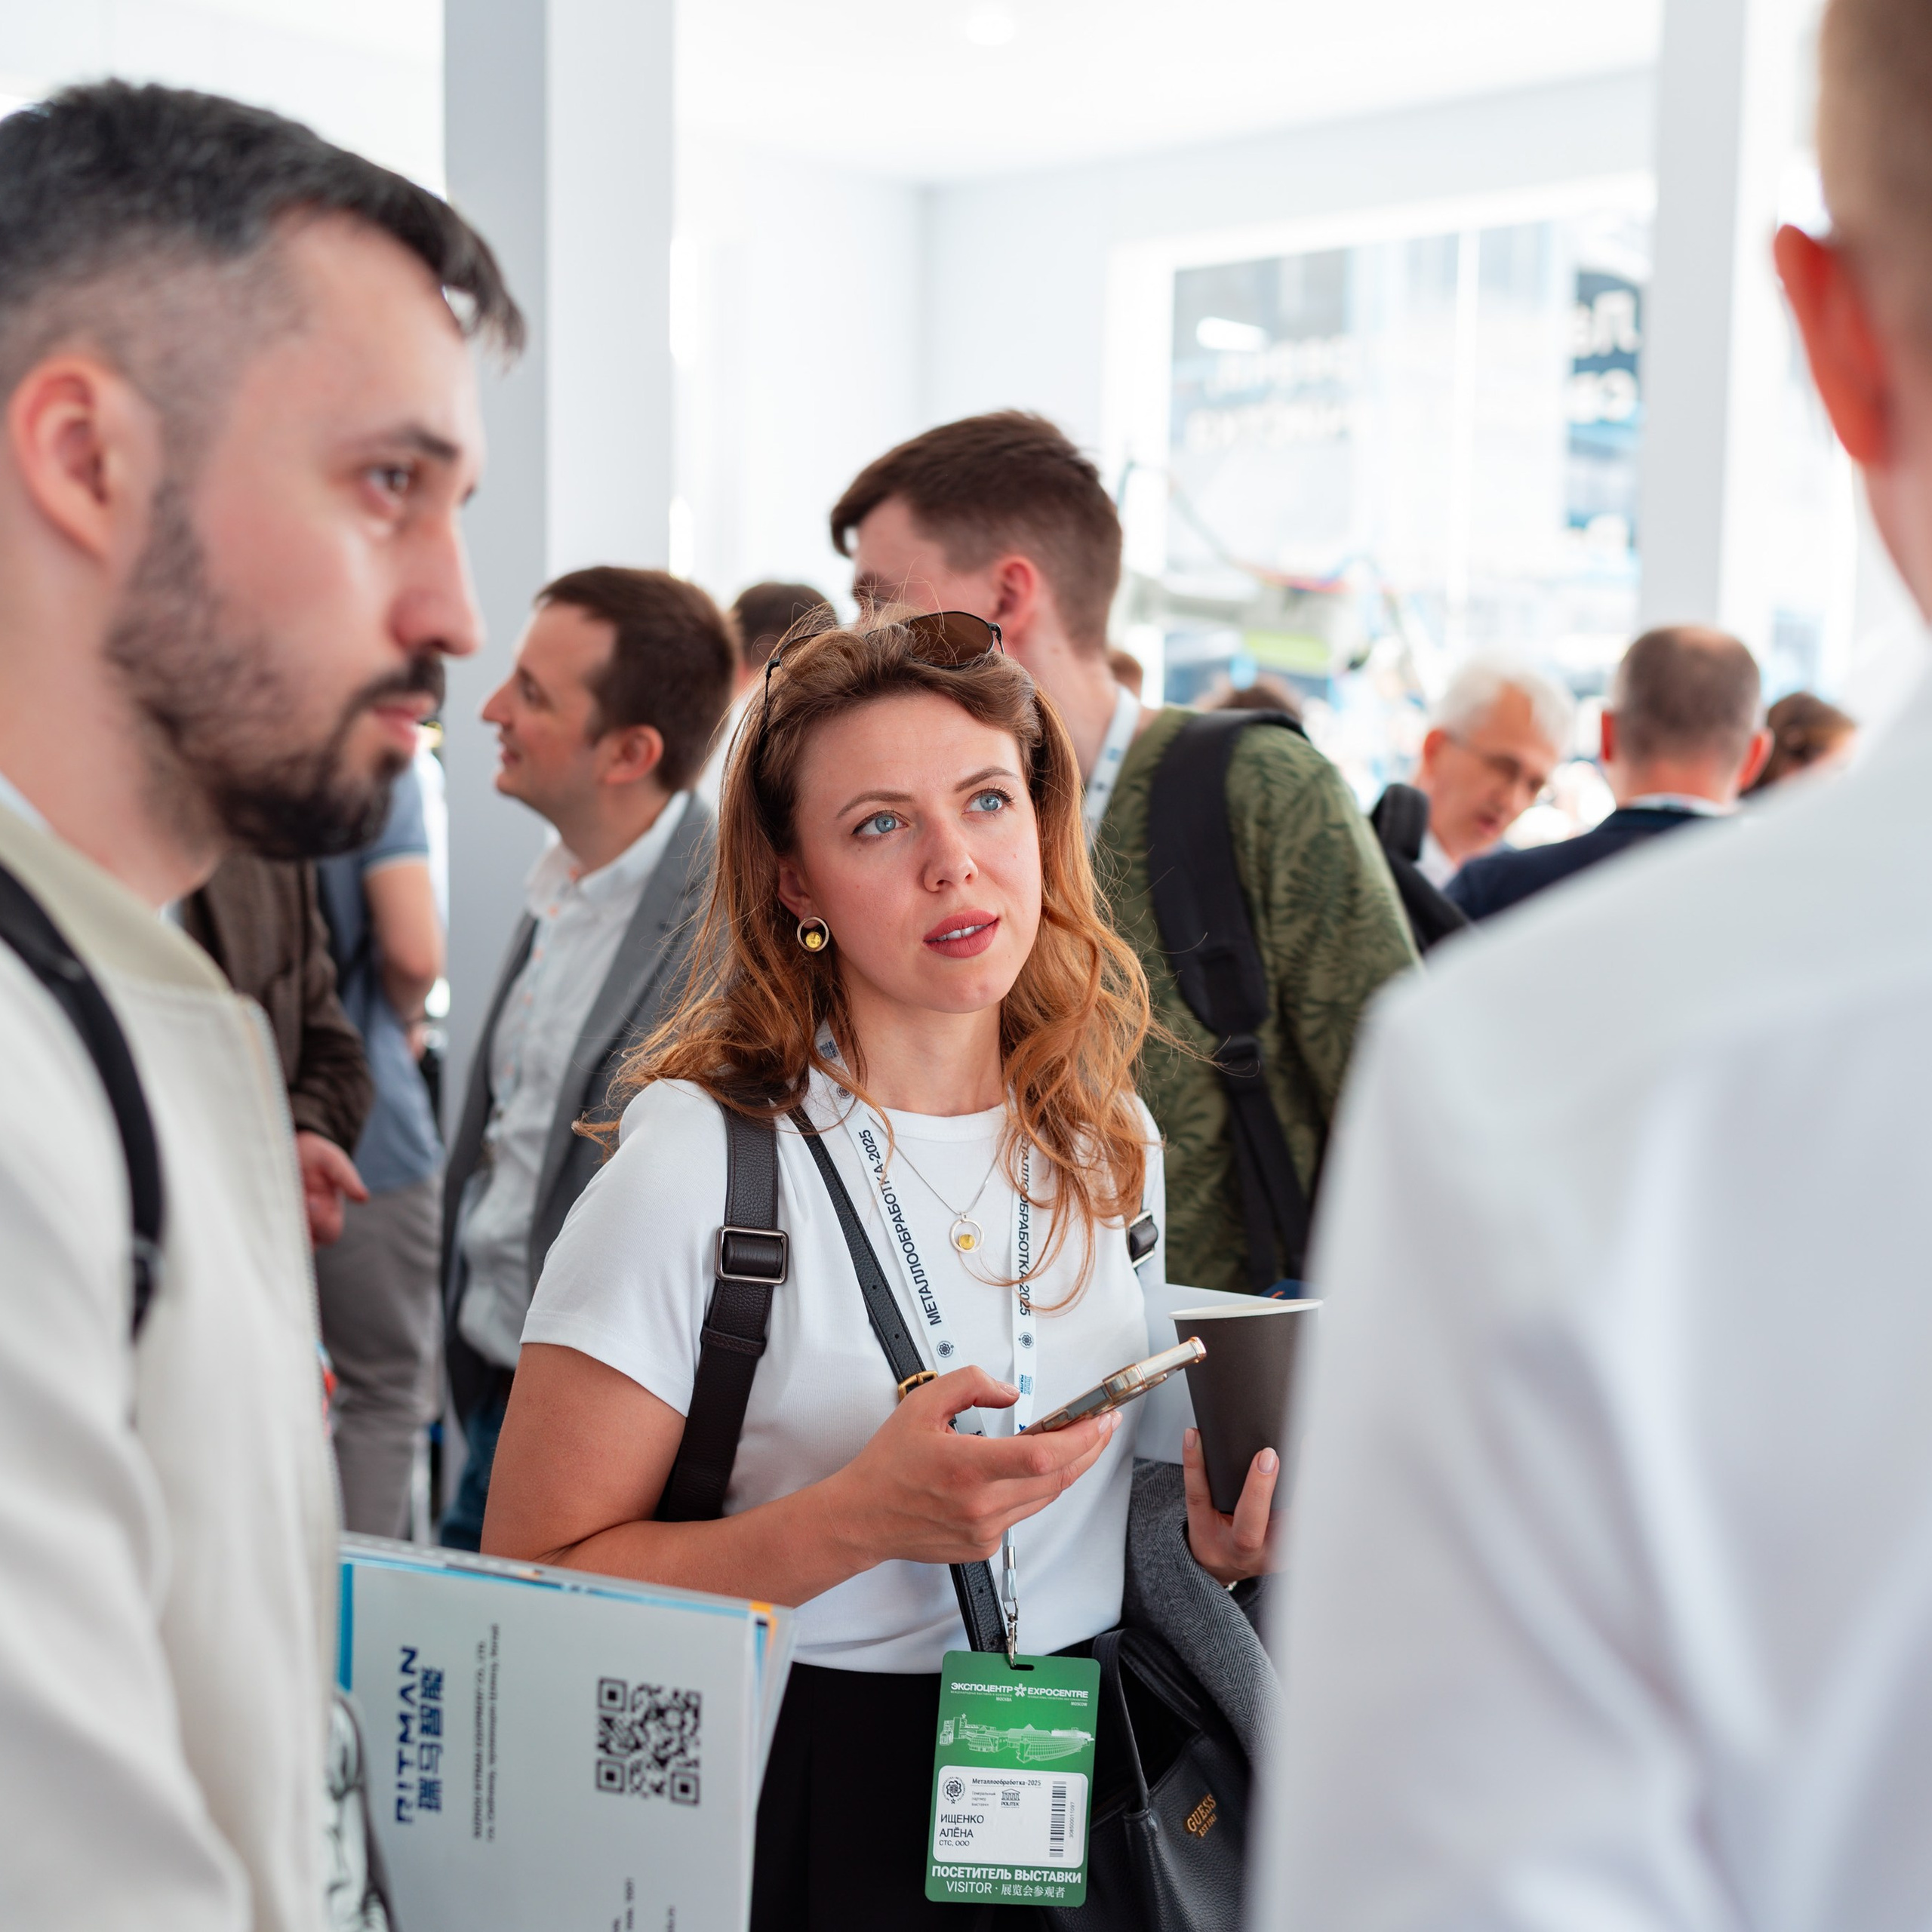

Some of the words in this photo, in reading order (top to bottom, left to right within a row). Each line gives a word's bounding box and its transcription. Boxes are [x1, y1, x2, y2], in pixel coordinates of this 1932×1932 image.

[859, 1129, 942, 1326] МЕТАЛЛООБРАБОТКА-2025
[950, 1682, 1013, 1694] ЭКСПОЦЕНТР
[1027, 1687, 1088, 1699] EXPOCENTRE
[395, 1645, 418, 1824] RITMAN
[971, 1778, 1041, 1786] Металлообработка-2025
[1186, 1793, 1217, 1832] GUESS
[940, 1814, 985, 1825] ИЩЕНКО
[939, 1827, 974, 1838] АЛЁНА
[931, 1866, 1012, 1880] ПОСЕТИТЕЛЬ
[1014, 1869, 1082, 1884] ВЫСТАВКИ
[946, 1881, 992, 1894] VISITOR
[1001, 1884, 1066, 1899] 展览会参观者
